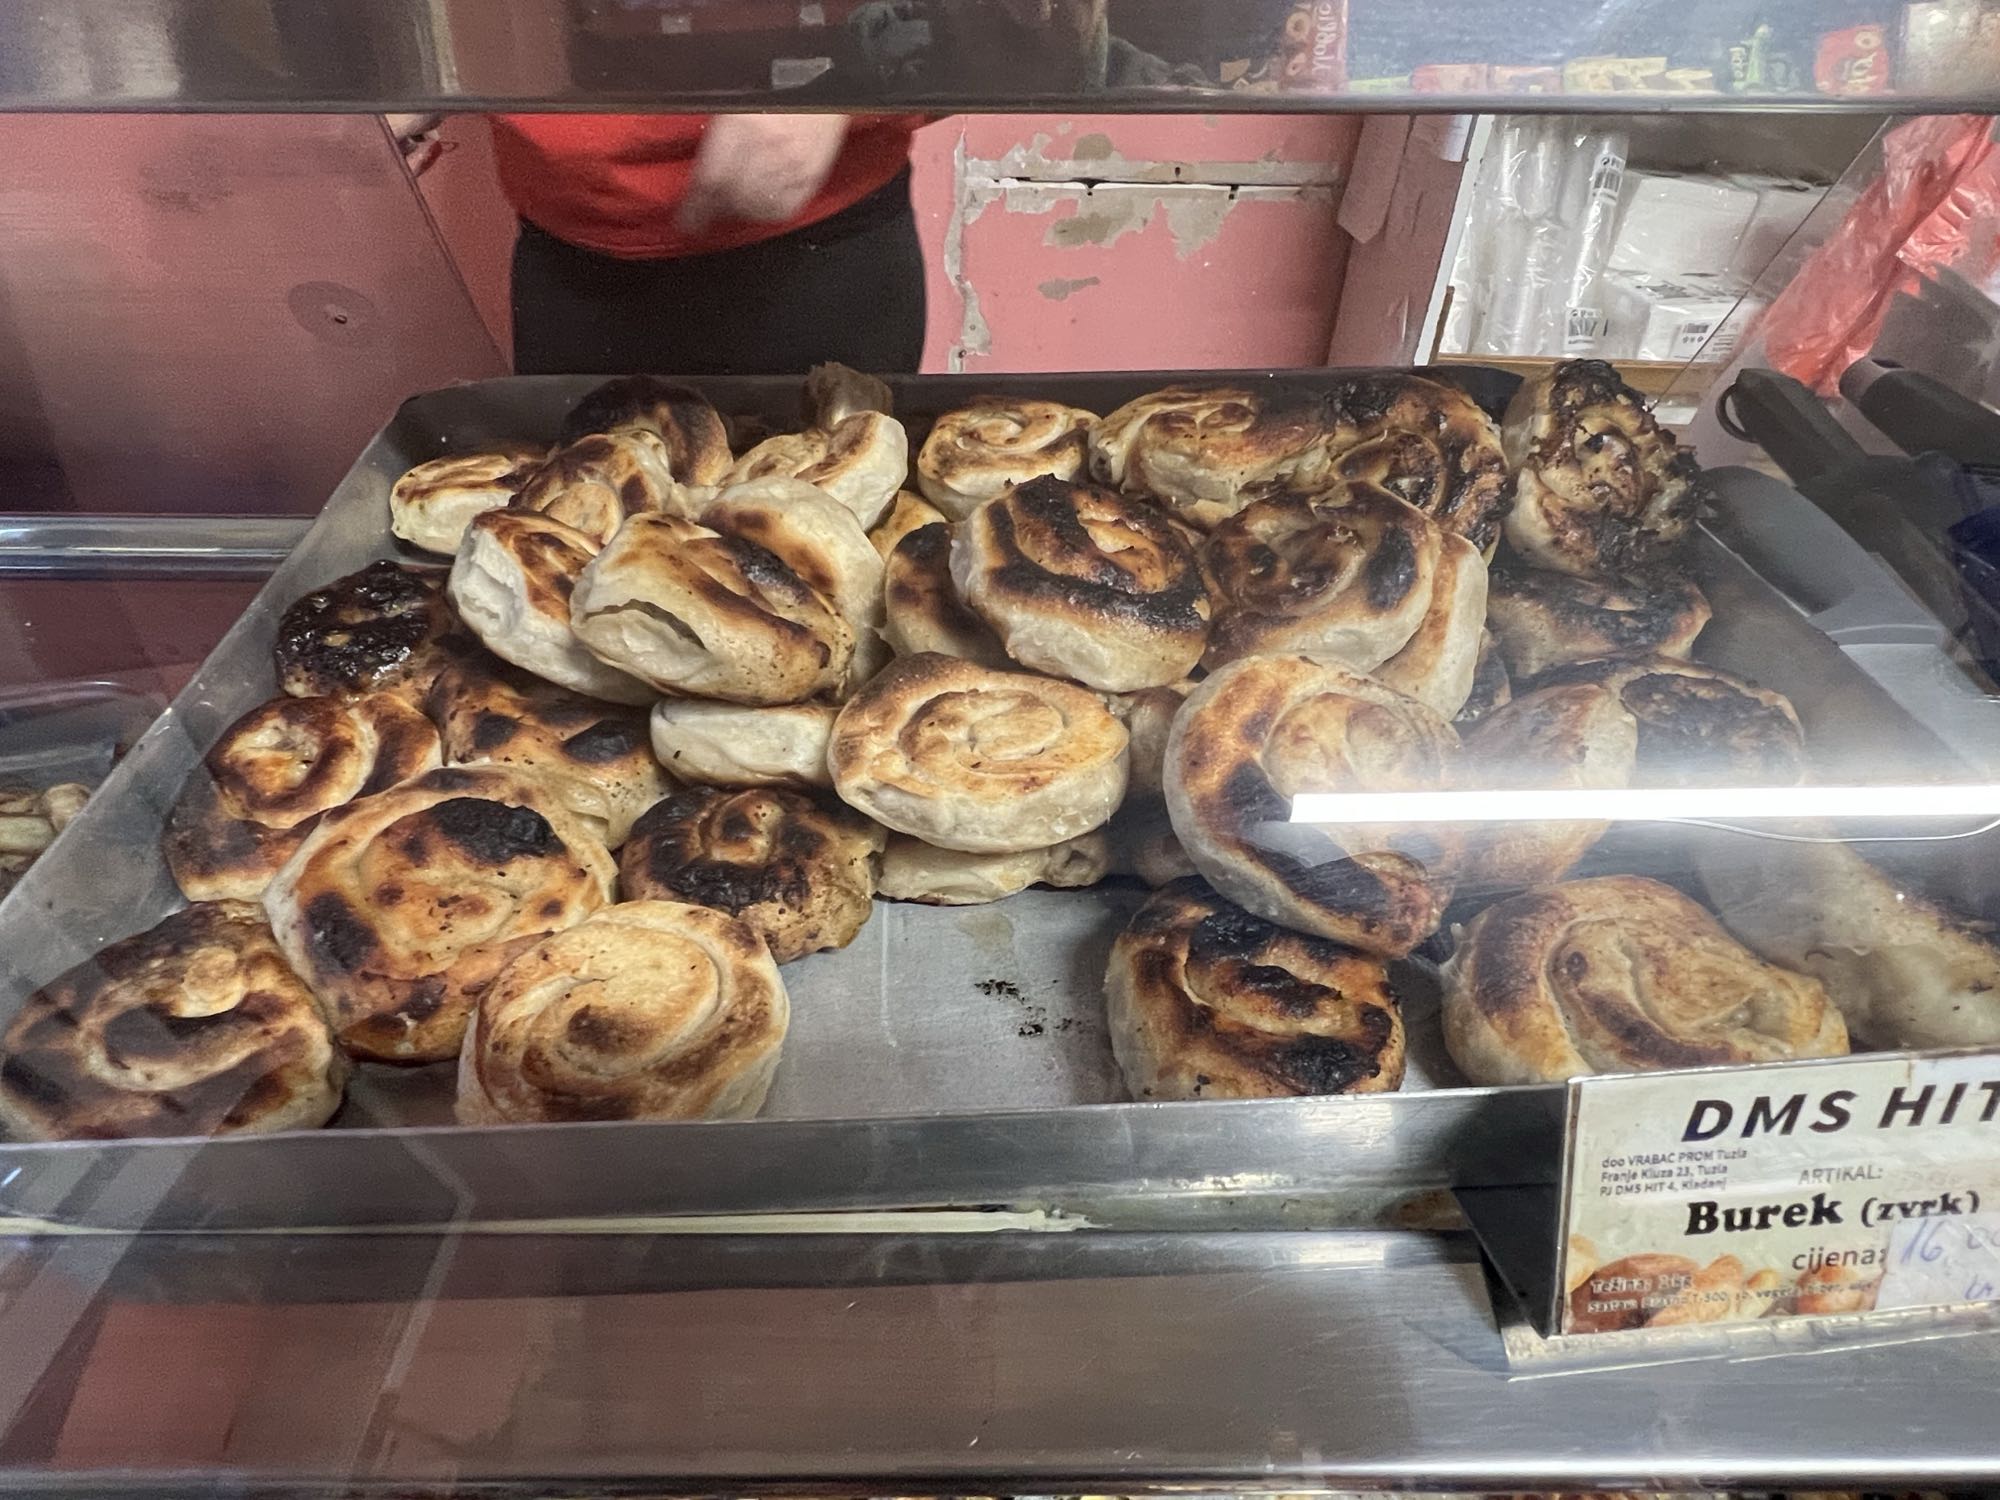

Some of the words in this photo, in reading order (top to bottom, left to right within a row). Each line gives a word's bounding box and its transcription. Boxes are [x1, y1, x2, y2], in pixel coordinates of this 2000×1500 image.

[1681, 1090, 1859, 1143] DMS
[1878, 1080, 2000, 1129] HIT
[1601, 1157, 1625, 1168] doo
[1628, 1153, 1676, 1166] VRABAC
[1678, 1151, 1714, 1163] PROM
[1716, 1148, 1748, 1160] Tuzla
[1600, 1169, 1638, 1183] Franje
[1697, 1164, 1728, 1176] Tuzla
[1799, 1167, 1883, 1185] ARTIKAL:
[1600, 1185, 1613, 1197] PJ
[1615, 1184, 1642, 1196] DMS
[1644, 1182, 1664, 1193] HIT
[1684, 1193, 1844, 1236] Burek
[1860, 1190, 1981, 1228] (zvrk)
[1792, 1247, 1887, 1274] cijena:
